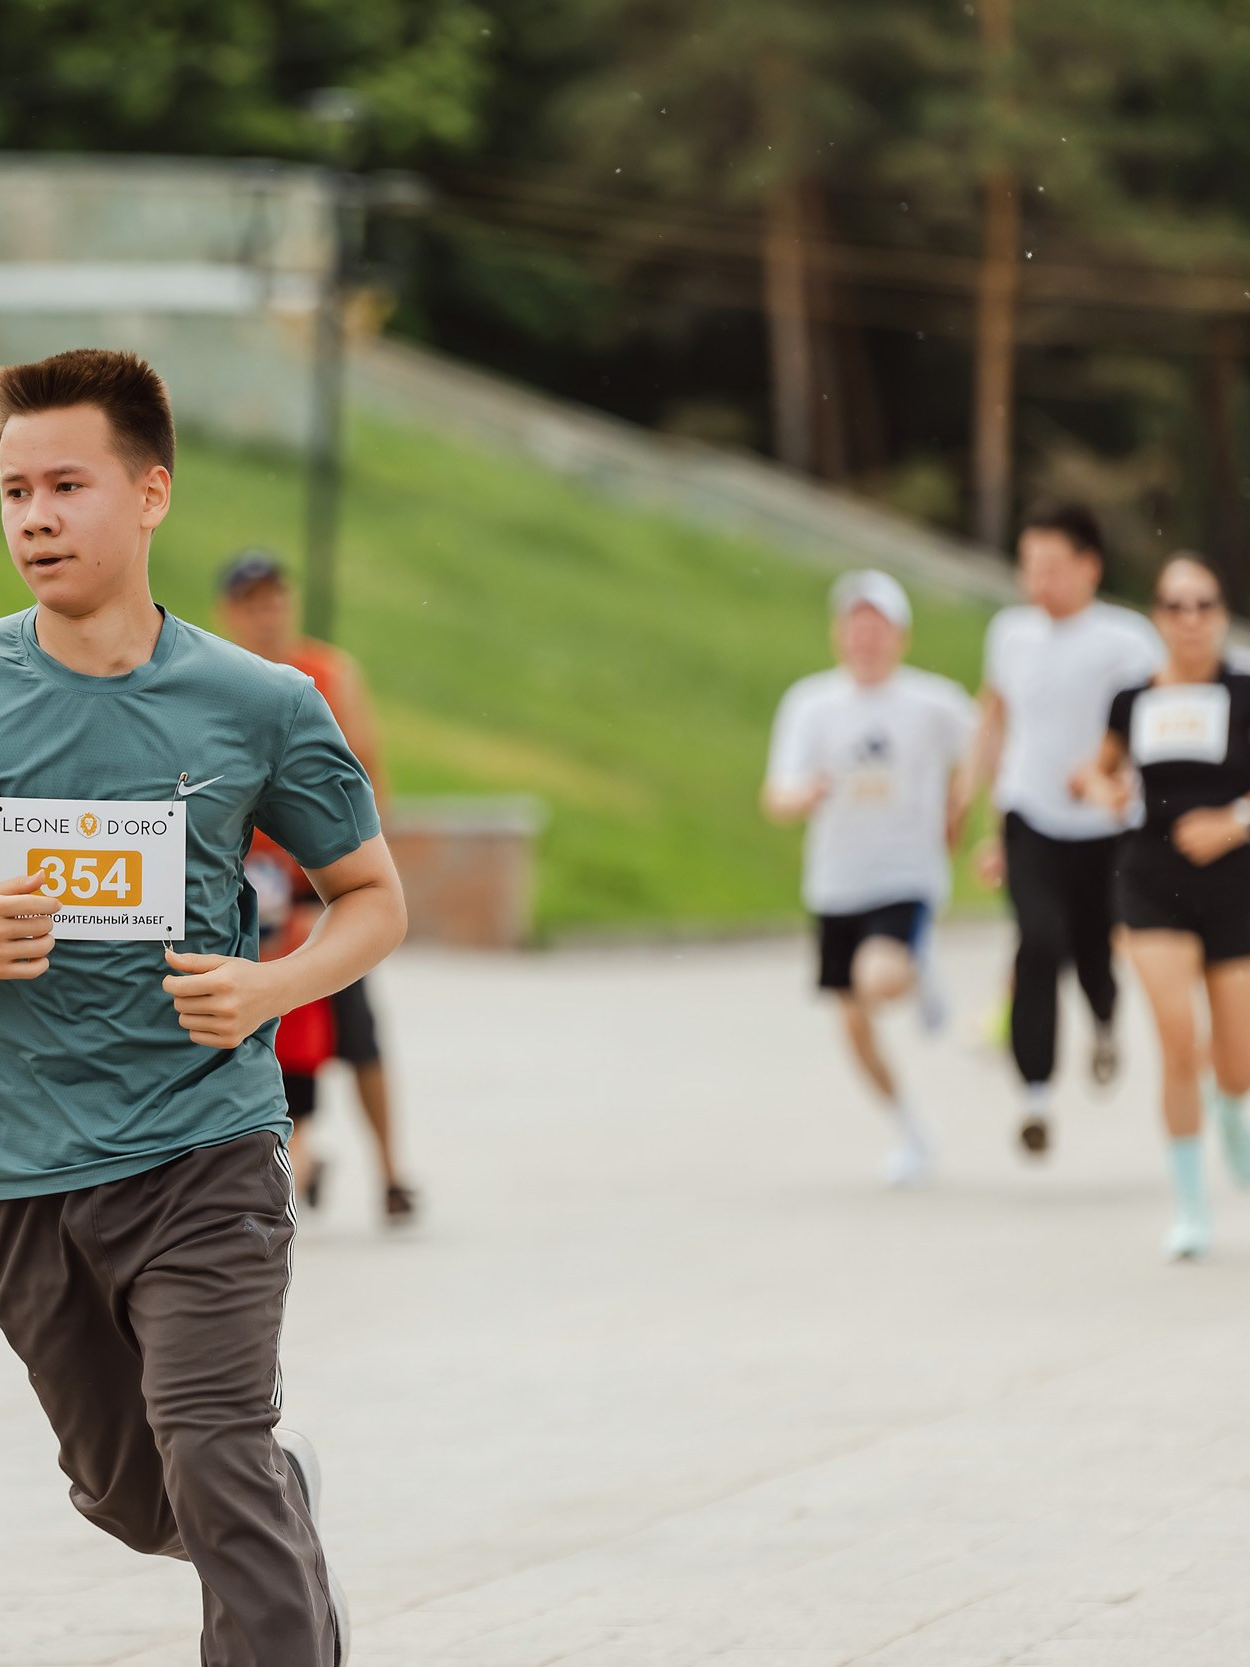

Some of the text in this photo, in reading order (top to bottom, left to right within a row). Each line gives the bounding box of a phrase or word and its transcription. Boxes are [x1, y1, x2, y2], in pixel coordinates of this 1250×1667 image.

[2, 816, 168, 836] LEONE D'ORO
[39, 855, 131, 900] 354
[14, 912, 164, 925] ОРИТЕЛЬНЫЙ ЗАБЕГ
